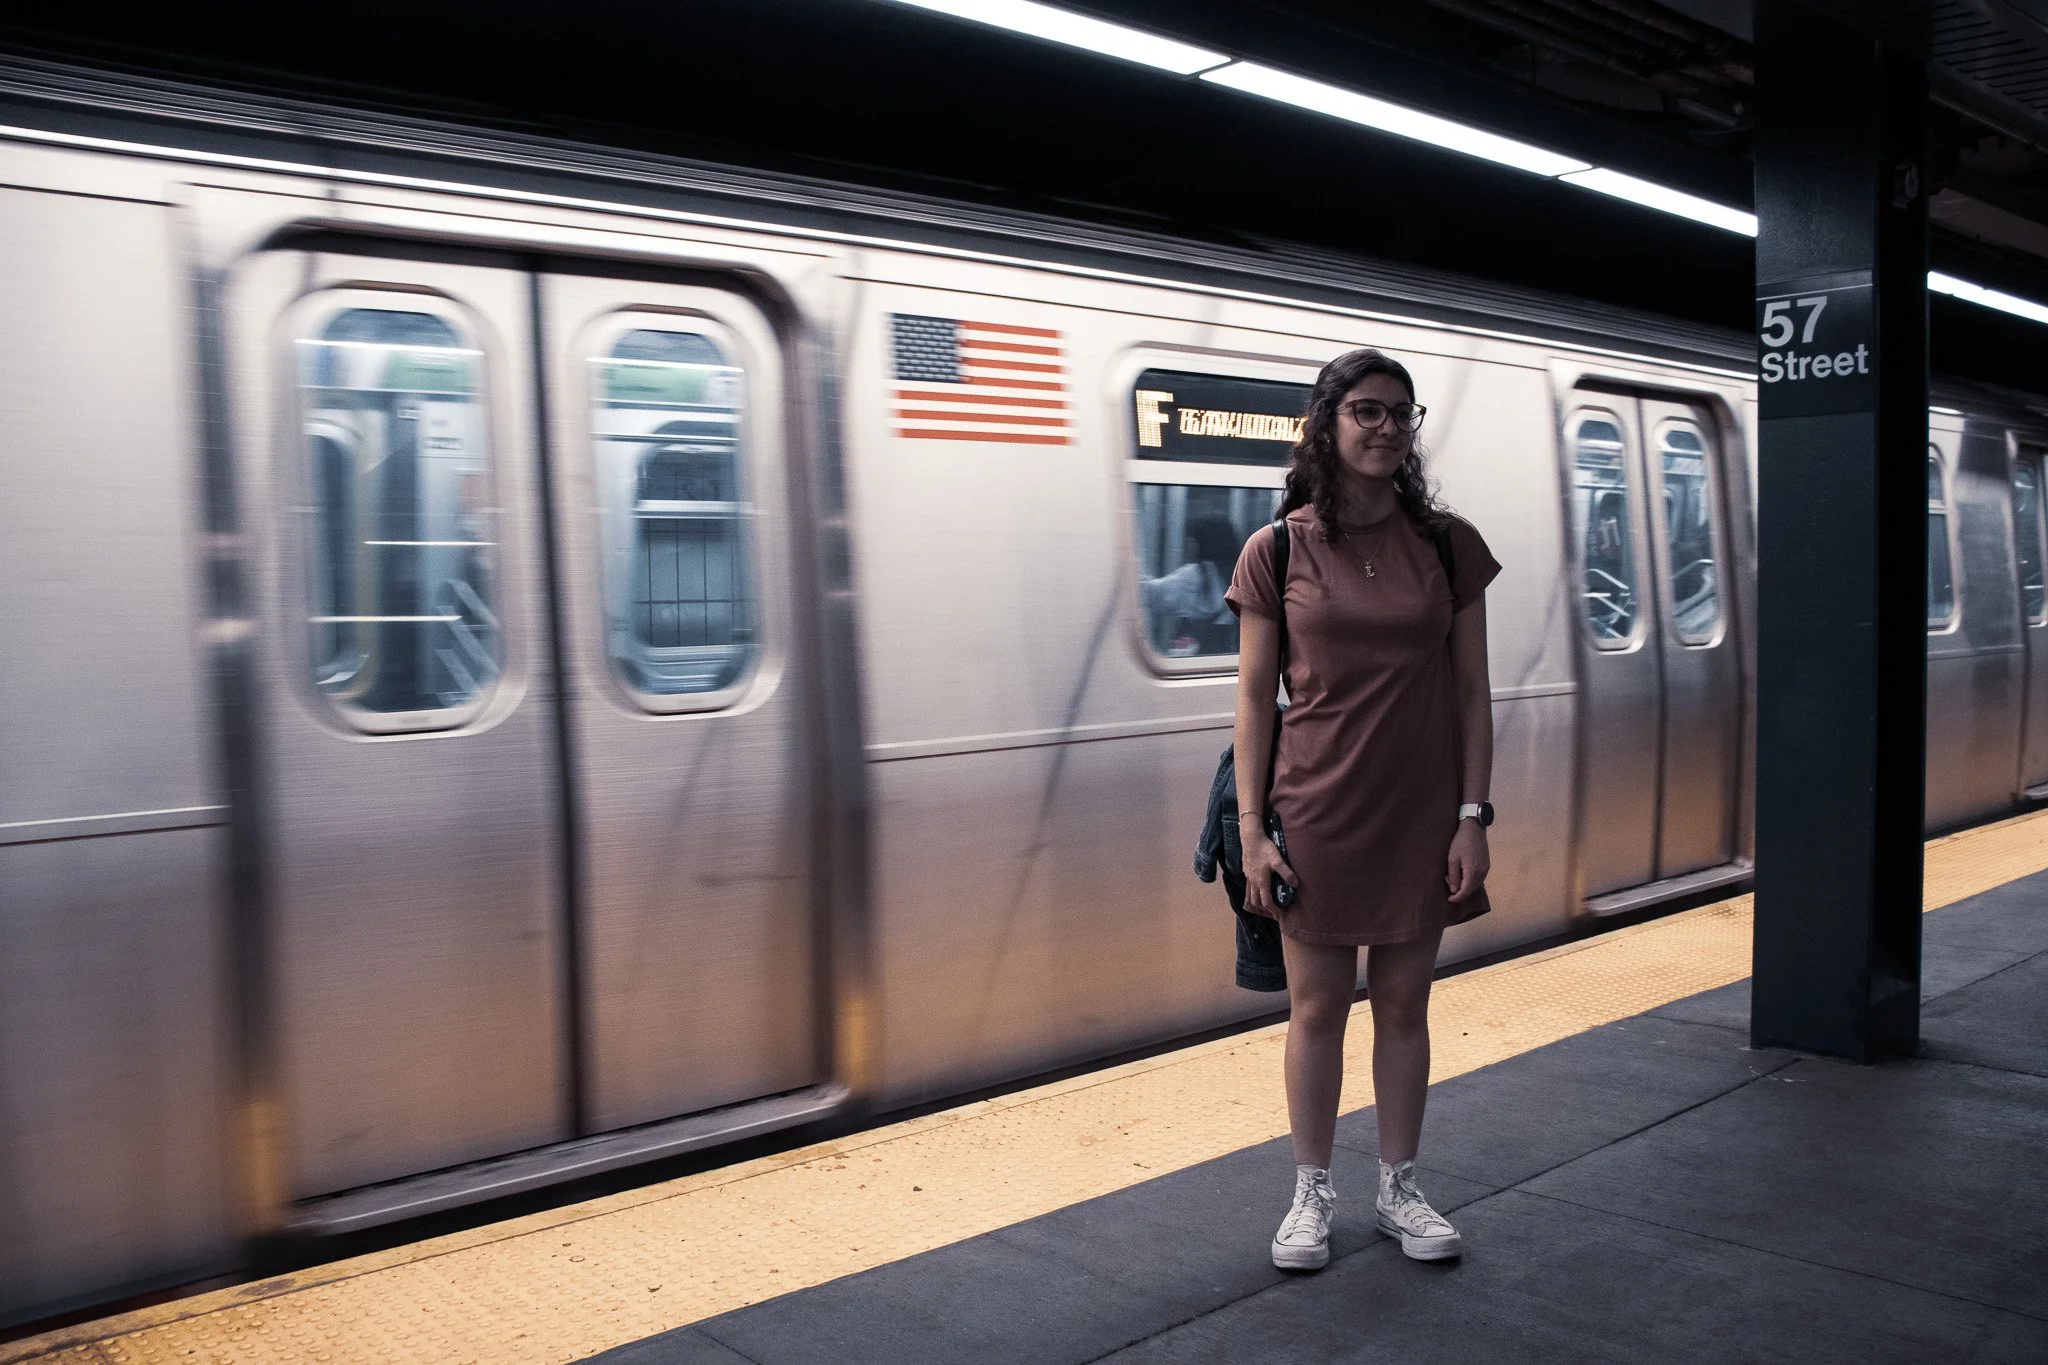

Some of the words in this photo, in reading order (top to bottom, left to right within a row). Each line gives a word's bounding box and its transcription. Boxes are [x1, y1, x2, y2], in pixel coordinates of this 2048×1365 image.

[1761, 296, 1828, 347] 57
[1761, 343, 1869, 383] Street
[1136, 389, 1174, 448] F
